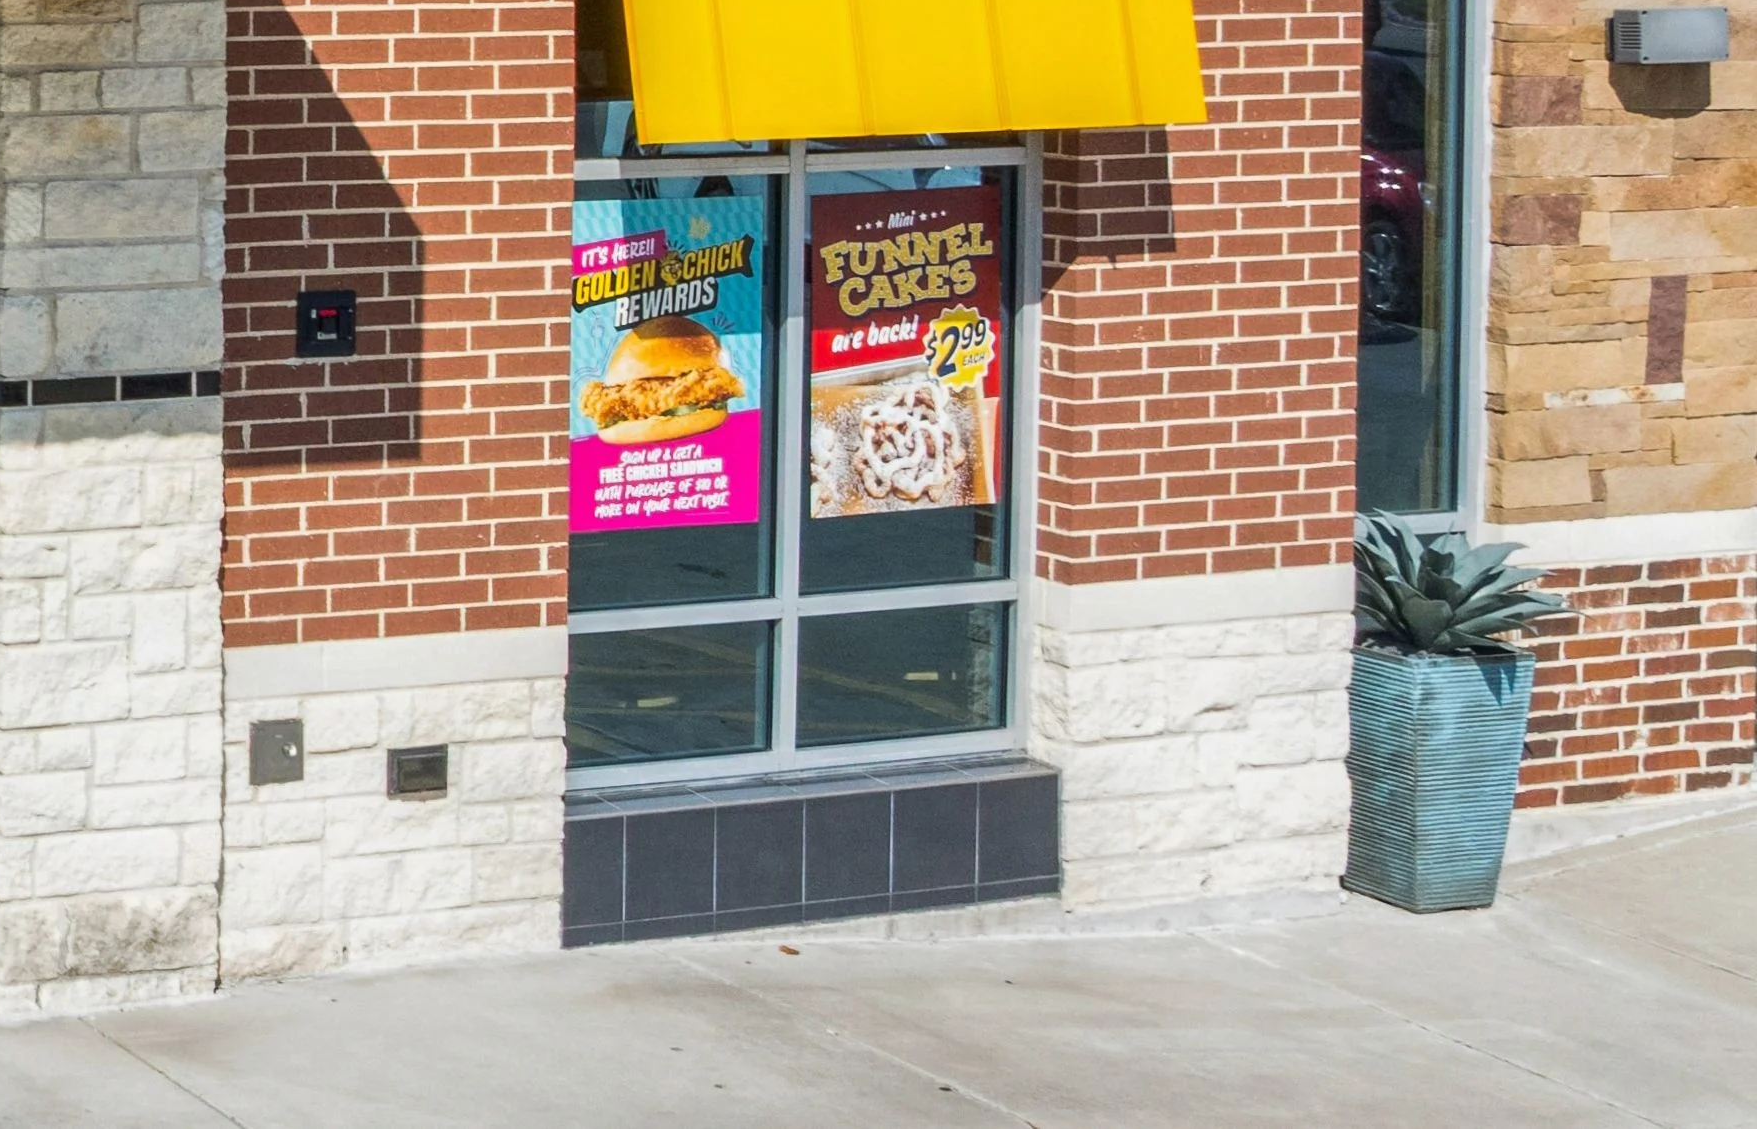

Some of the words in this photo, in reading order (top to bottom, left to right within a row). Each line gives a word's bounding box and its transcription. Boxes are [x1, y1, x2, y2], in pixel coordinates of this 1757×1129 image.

[887, 210, 916, 230] Mini
[575, 259, 657, 305] GOLDEN
[682, 239, 745, 282] CHICK
[581, 246, 608, 268] IT'S
[820, 223, 993, 284] FUNNEL
[614, 277, 717, 329] REWARDS
[839, 259, 977, 317] CAKES
[831, 329, 864, 353] are
[867, 314, 919, 347] back!
[599, 466, 625, 484] FREE
[626, 462, 669, 481] CHICKEN
[670, 458, 723, 477] SANDWICH
[678, 478, 694, 493] OF
